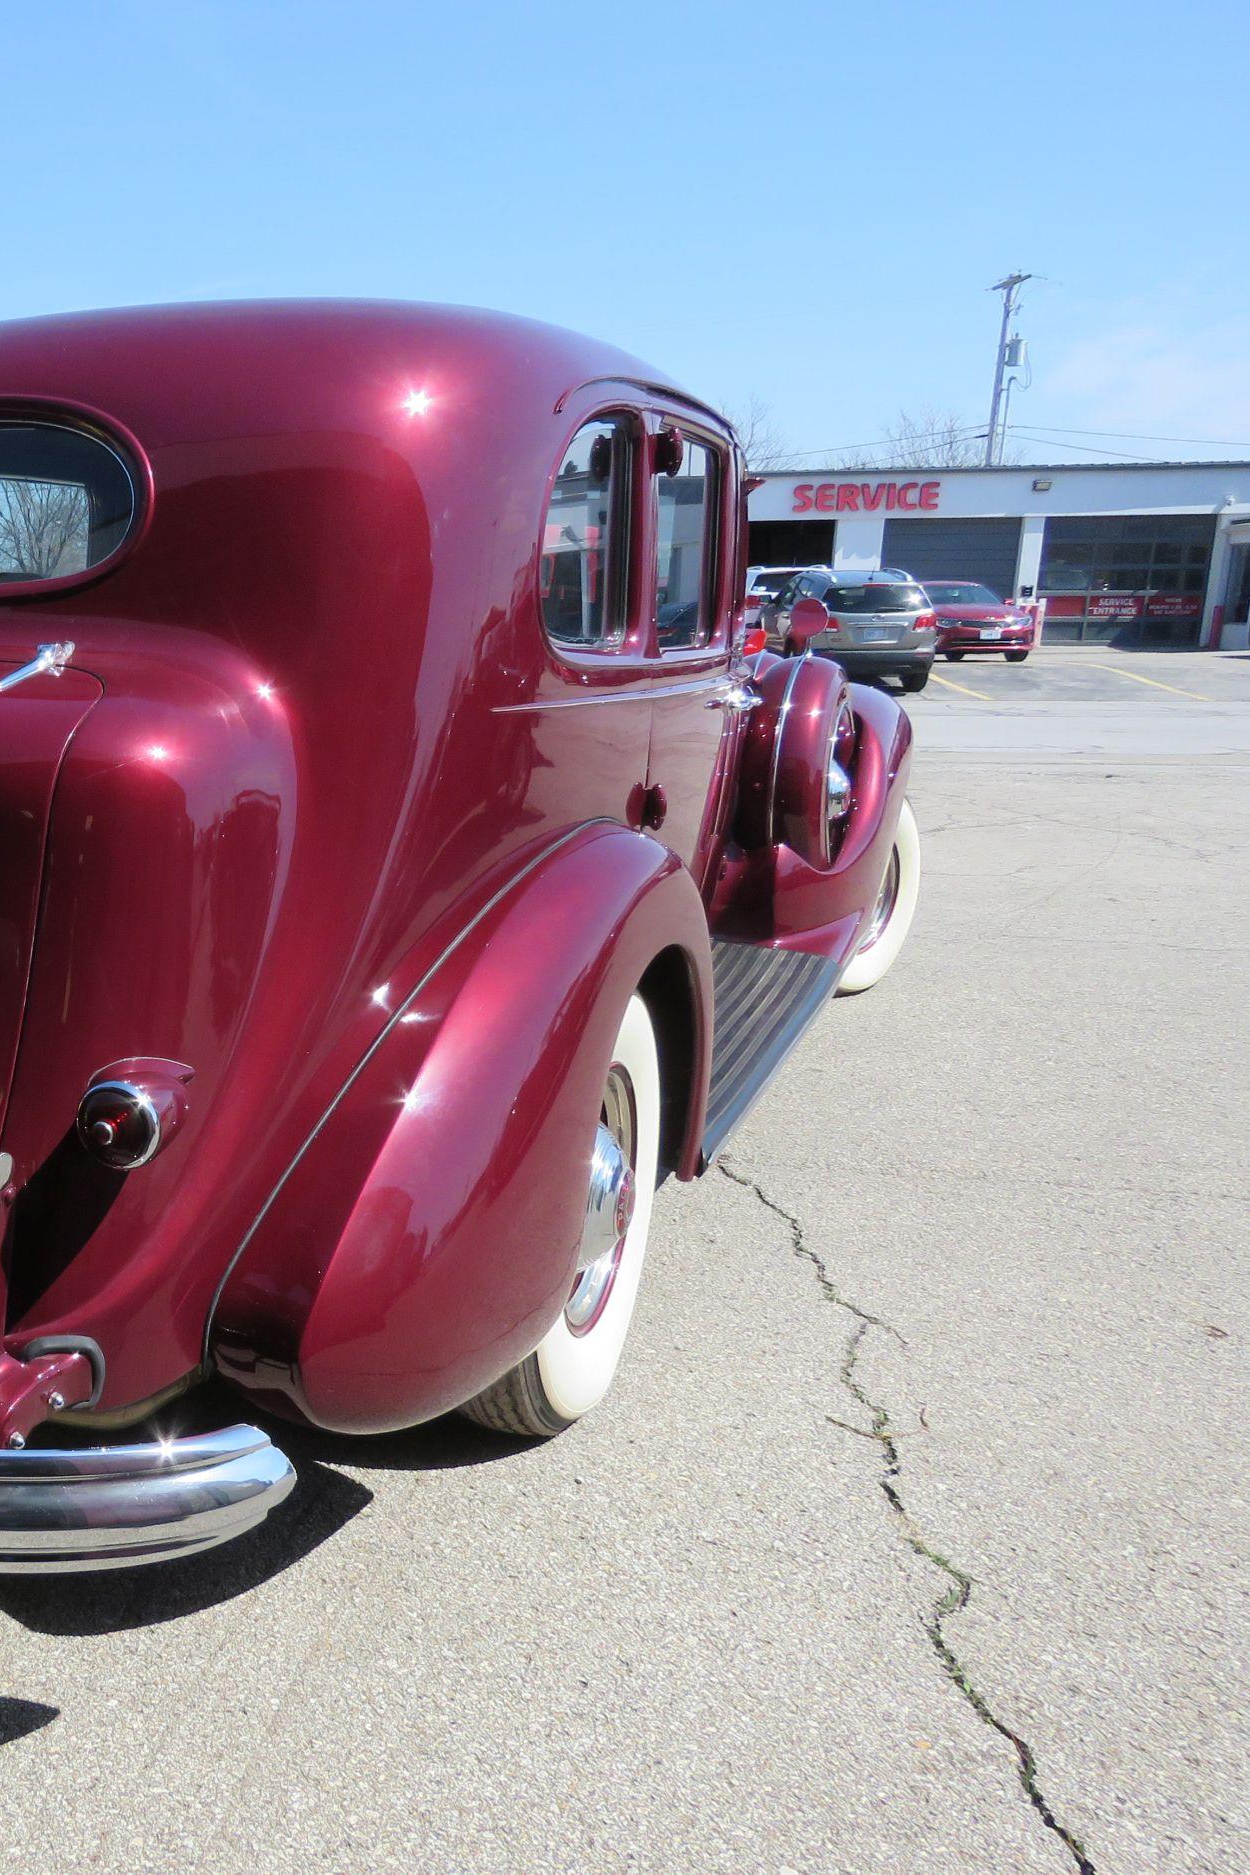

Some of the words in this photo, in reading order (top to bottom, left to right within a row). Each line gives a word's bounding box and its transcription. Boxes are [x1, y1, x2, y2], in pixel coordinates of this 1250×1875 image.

[792, 482, 940, 513] SERVICE
[1098, 598, 1134, 606] SERVICE
[1093, 607, 1137, 615] ENTRANCE
